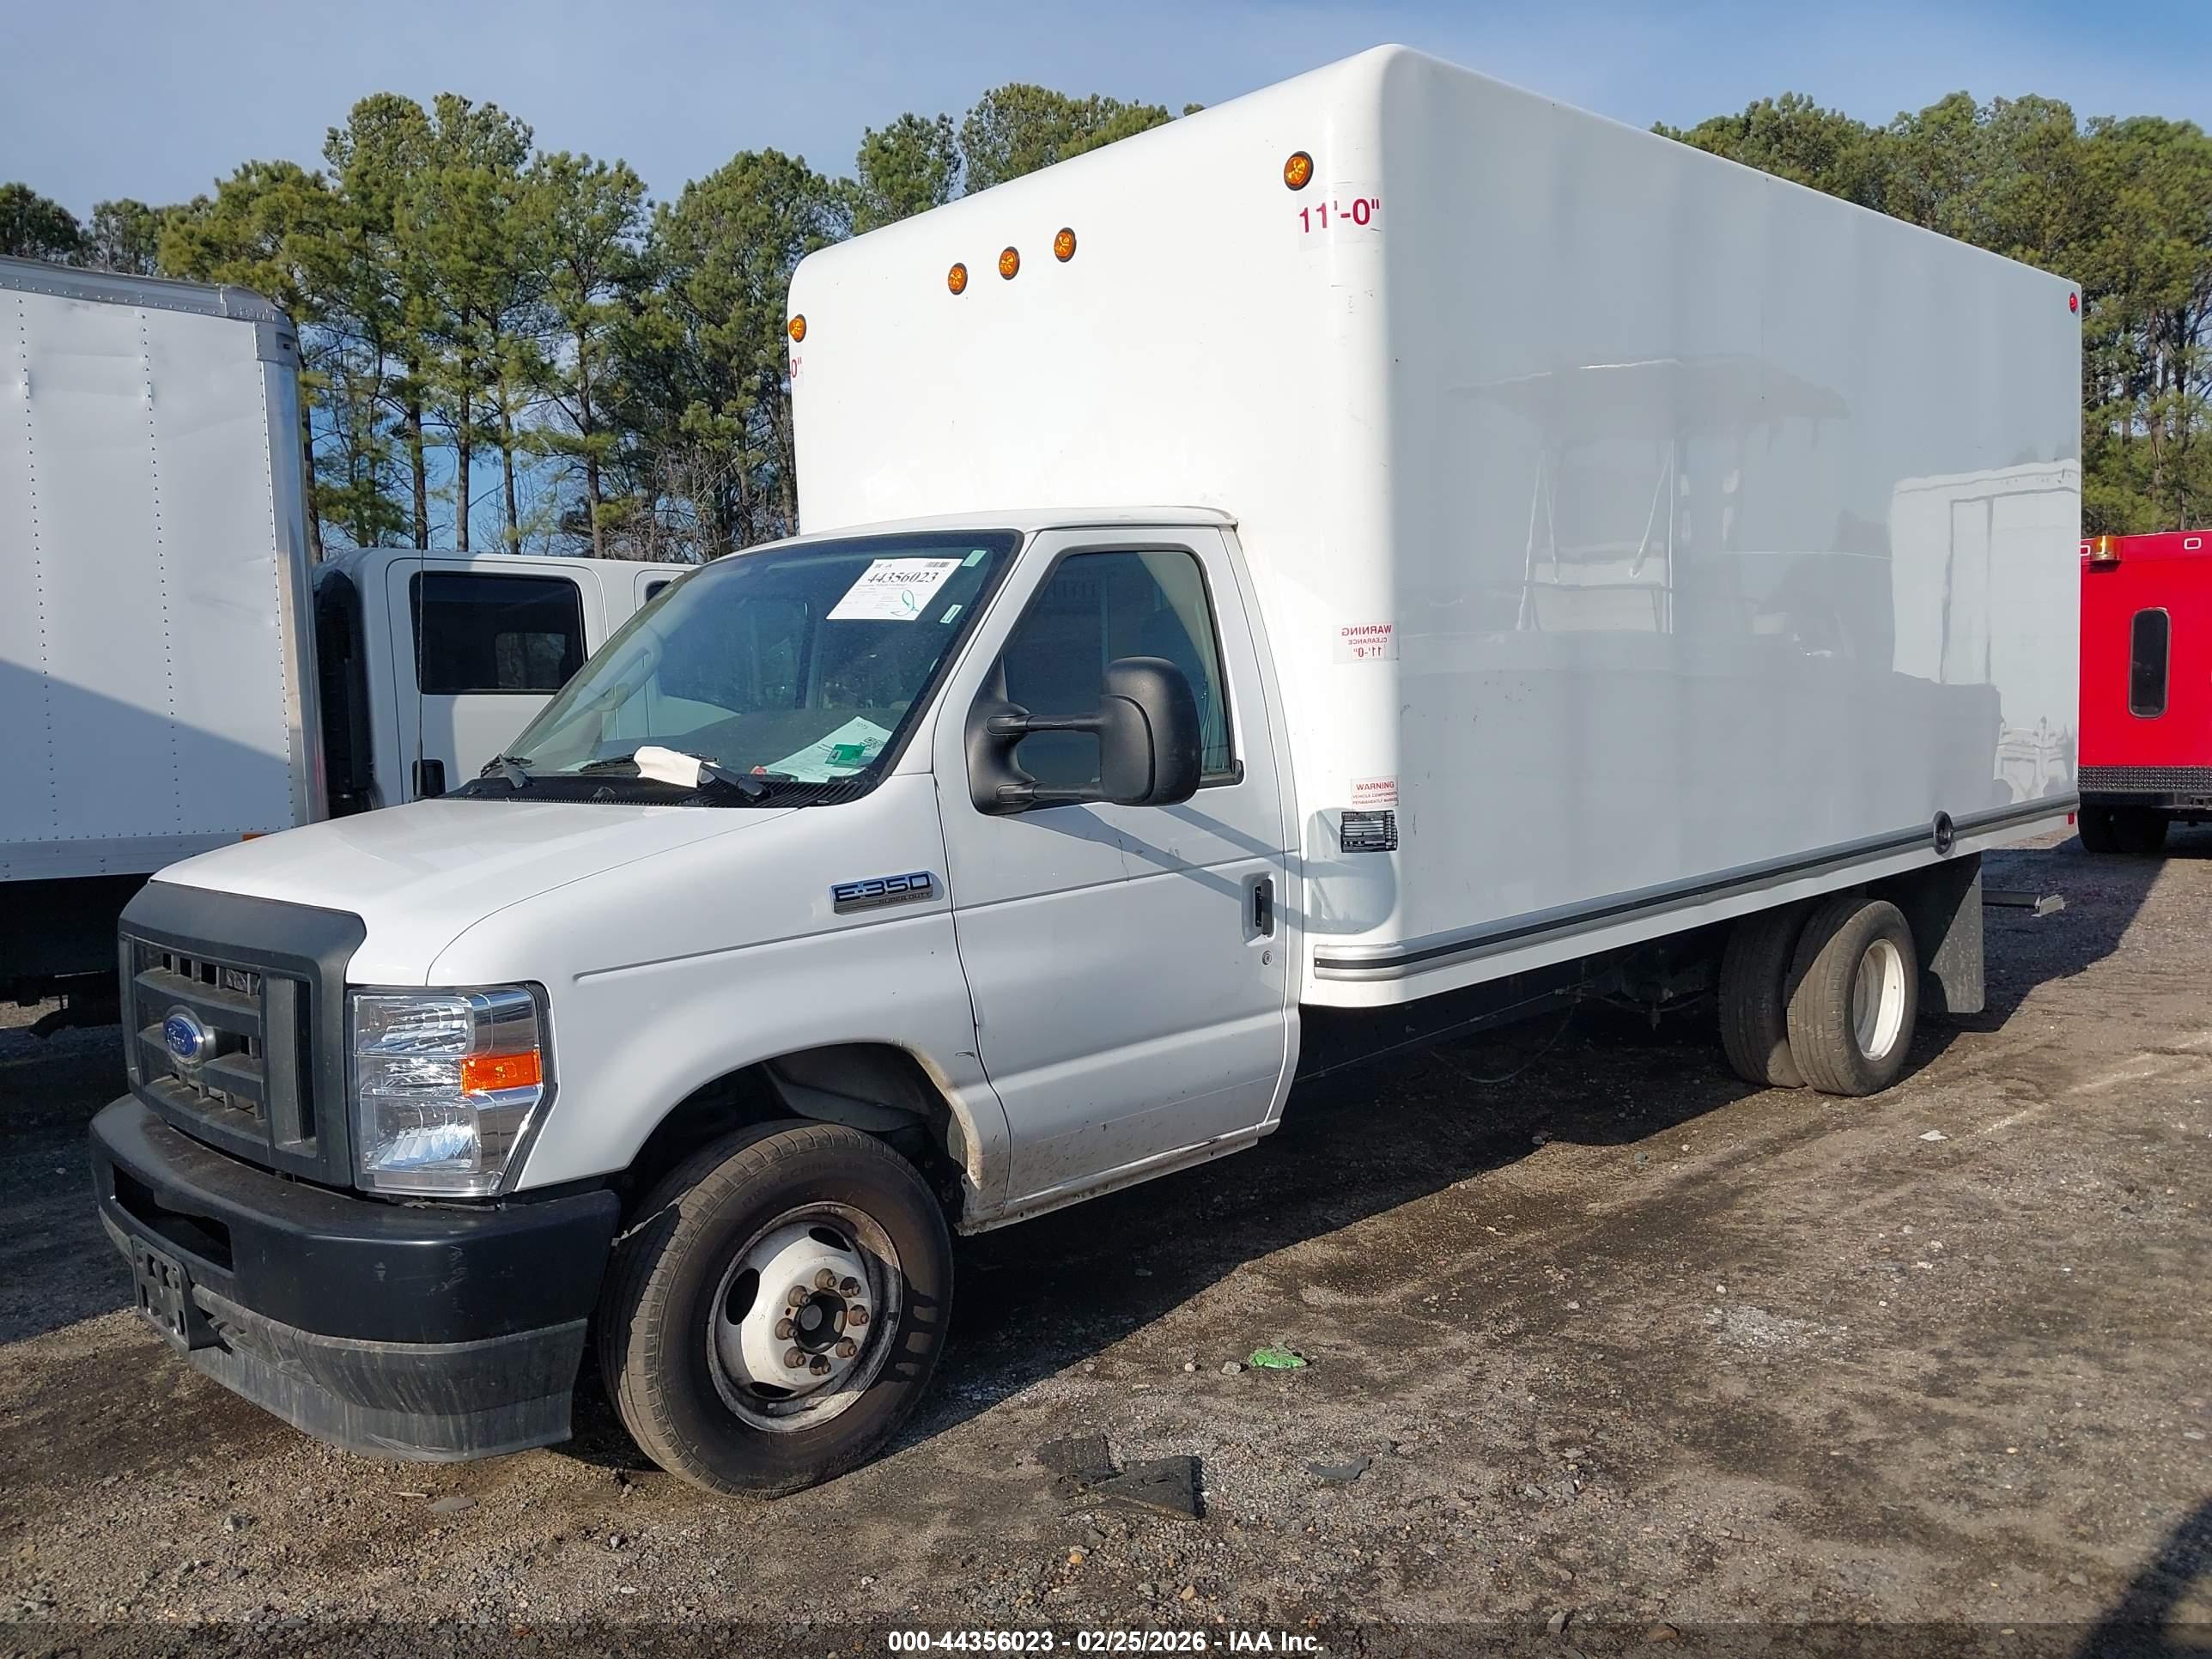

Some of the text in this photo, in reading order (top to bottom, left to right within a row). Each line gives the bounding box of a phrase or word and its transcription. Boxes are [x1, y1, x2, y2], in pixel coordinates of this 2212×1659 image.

[1299, 198, 1380, 233] 11'-0"
[867, 571, 939, 583] 44356023
[1356, 781, 1395, 791] WARNING
[834, 872, 931, 902] E-350
